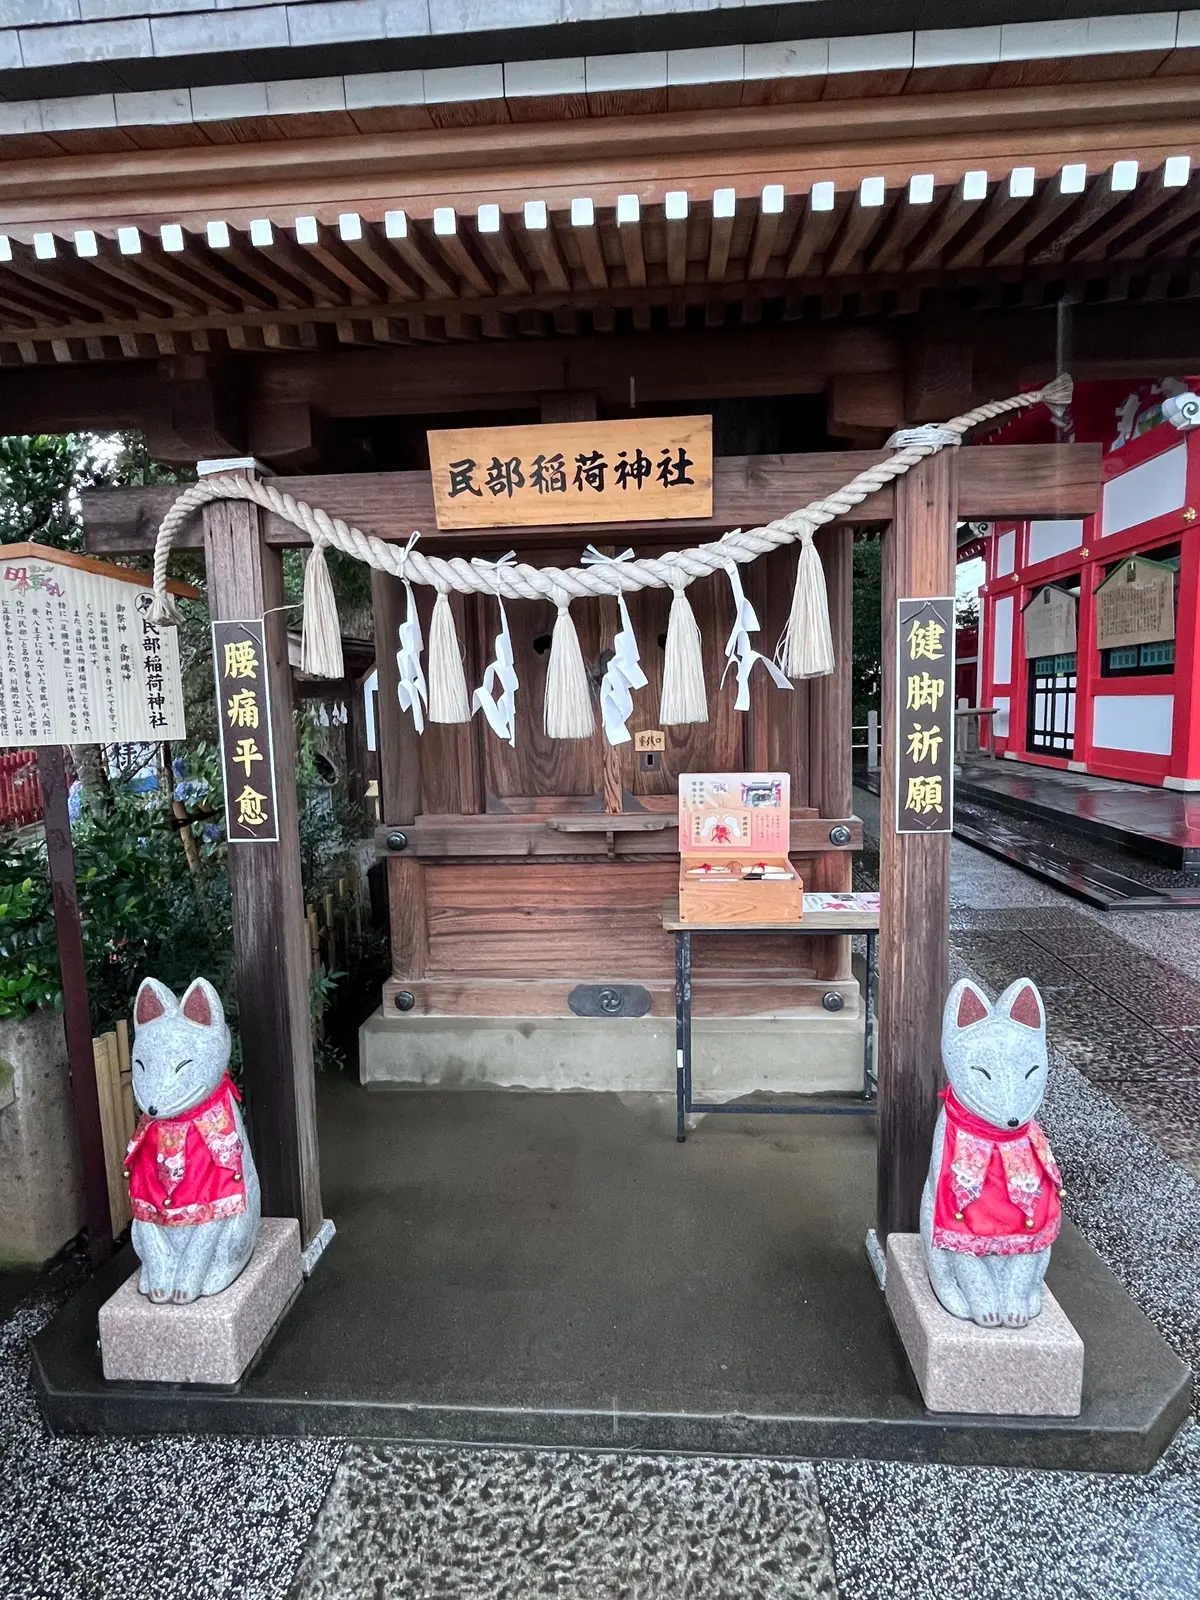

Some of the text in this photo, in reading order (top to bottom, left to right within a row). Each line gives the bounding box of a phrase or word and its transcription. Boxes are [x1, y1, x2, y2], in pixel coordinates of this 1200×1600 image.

[447, 447, 695, 498] 民部稲荷神社
[45, 601, 58, 651] されています。
[86, 603, 100, 669] くださる神様です。
[115, 603, 127, 633] 御祭神
[141, 617, 169, 730] 民部稲荷神社
[905, 619, 946, 815] 健脚祈願
